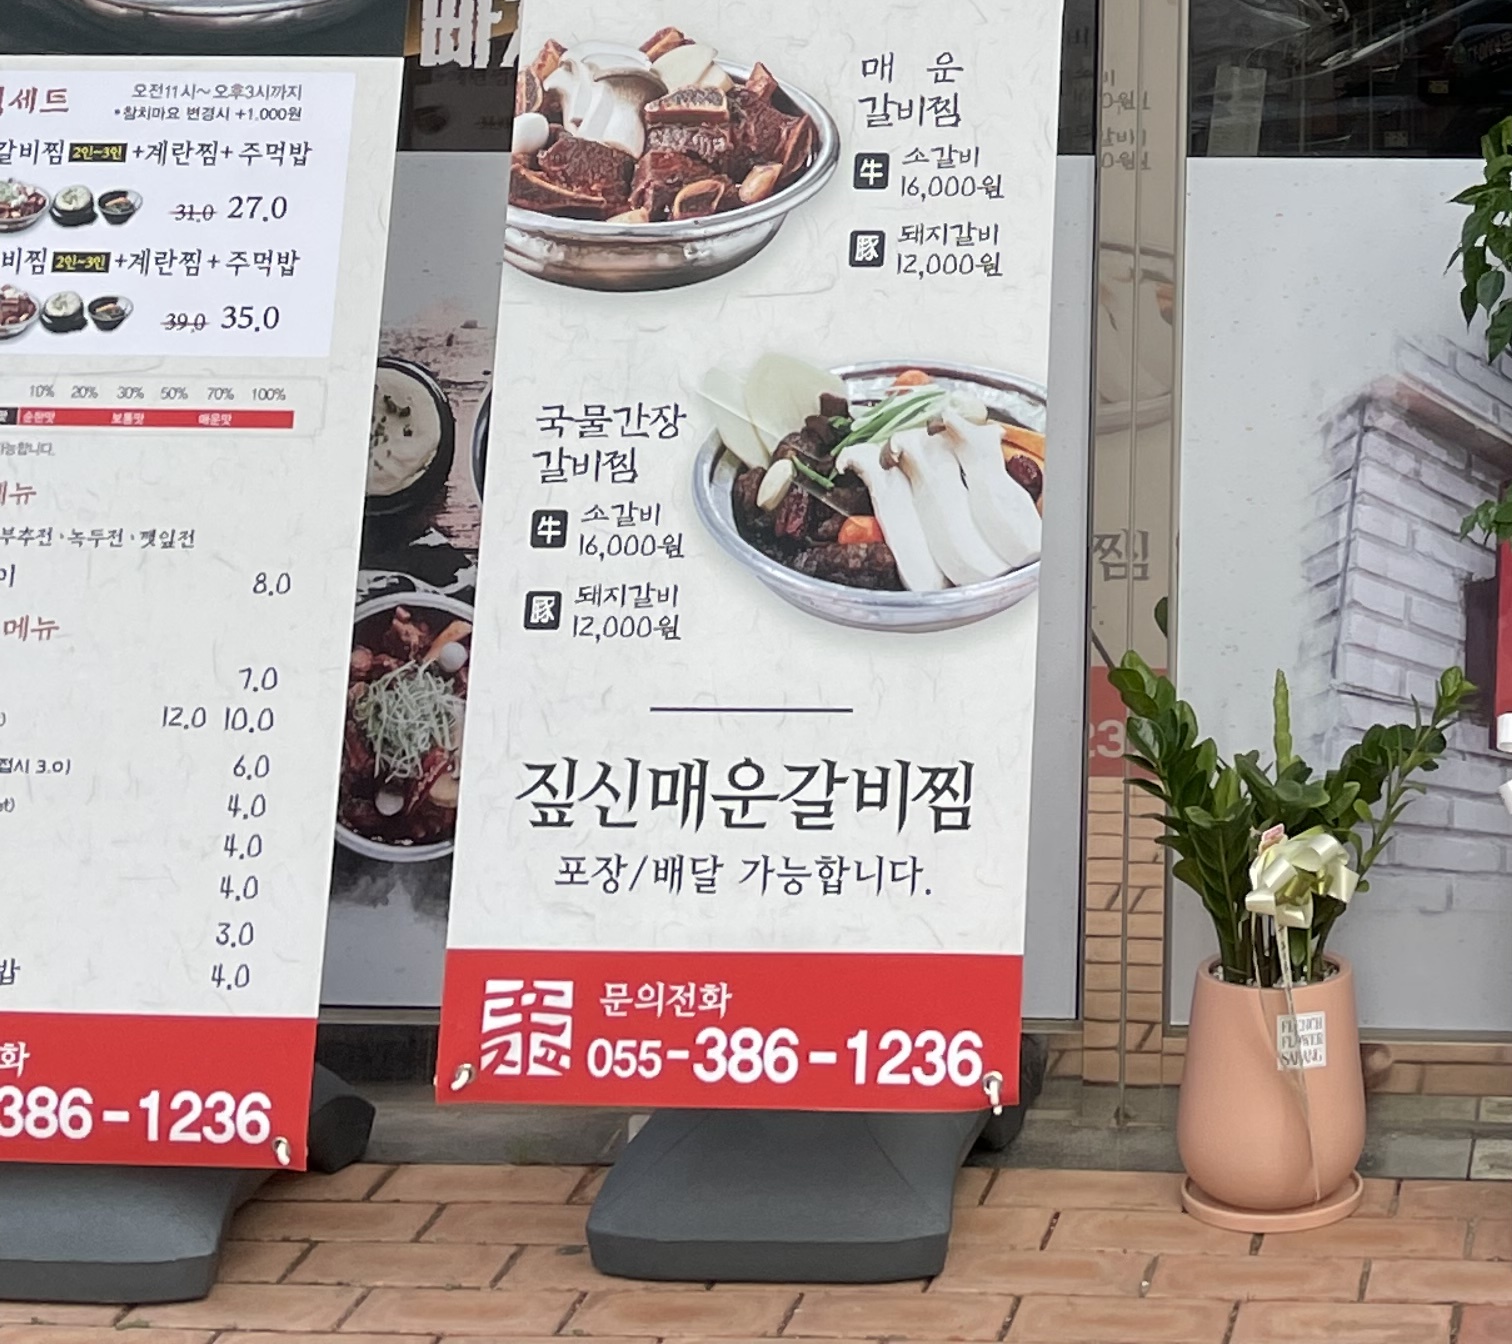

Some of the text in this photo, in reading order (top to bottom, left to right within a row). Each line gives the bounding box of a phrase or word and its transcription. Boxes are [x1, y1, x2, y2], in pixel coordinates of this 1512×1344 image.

[0, 86, 69, 115] 세트
[858, 92, 962, 129] 갈비찜
[238, 140, 313, 167] 주먹밥
[901, 145, 981, 170] 소갈비
[857, 157, 885, 185] 牛
[899, 174, 1005, 202] 16,000원
[227, 196, 288, 223] 27.0
[896, 223, 1000, 249] 돼지갈비
[225, 249, 301, 278] 주먹밥
[895, 251, 1004, 279] 12,000원
[221, 305, 281, 333] 35.0
[29, 384, 287, 403] 10% 20% 30% 50% 70% 100%
[535, 402, 688, 440] 국물간장
[532, 448, 640, 486] 갈비찜
[536, 515, 564, 543] 牛
[580, 502, 661, 529] 소갈비
[578, 531, 685, 560] 16,000원
[252, 572, 292, 597] 8.0
[574, 583, 680, 610] 돼지갈비
[3, 614, 60, 642] 메뉴
[571, 612, 683, 642] 12,000원
[239, 666, 279, 693] 7.0
[162, 706, 275, 734] 12.0 10.0
[232, 754, 270, 781] 6.0
[228, 793, 267, 821] 4.0
[515, 756, 975, 834] 짚신매운갈비찜
[224, 834, 263, 861] 4.0
[219, 875, 259, 902] 4.0
[554, 853, 933, 898] 포장/배달 가능합니다.
[215, 922, 255, 948] 3.0
[211, 963, 250, 990] 4.0
[599, 980, 733, 1019] 문의전화
[586, 1026, 984, 1087] 055-386-1236
